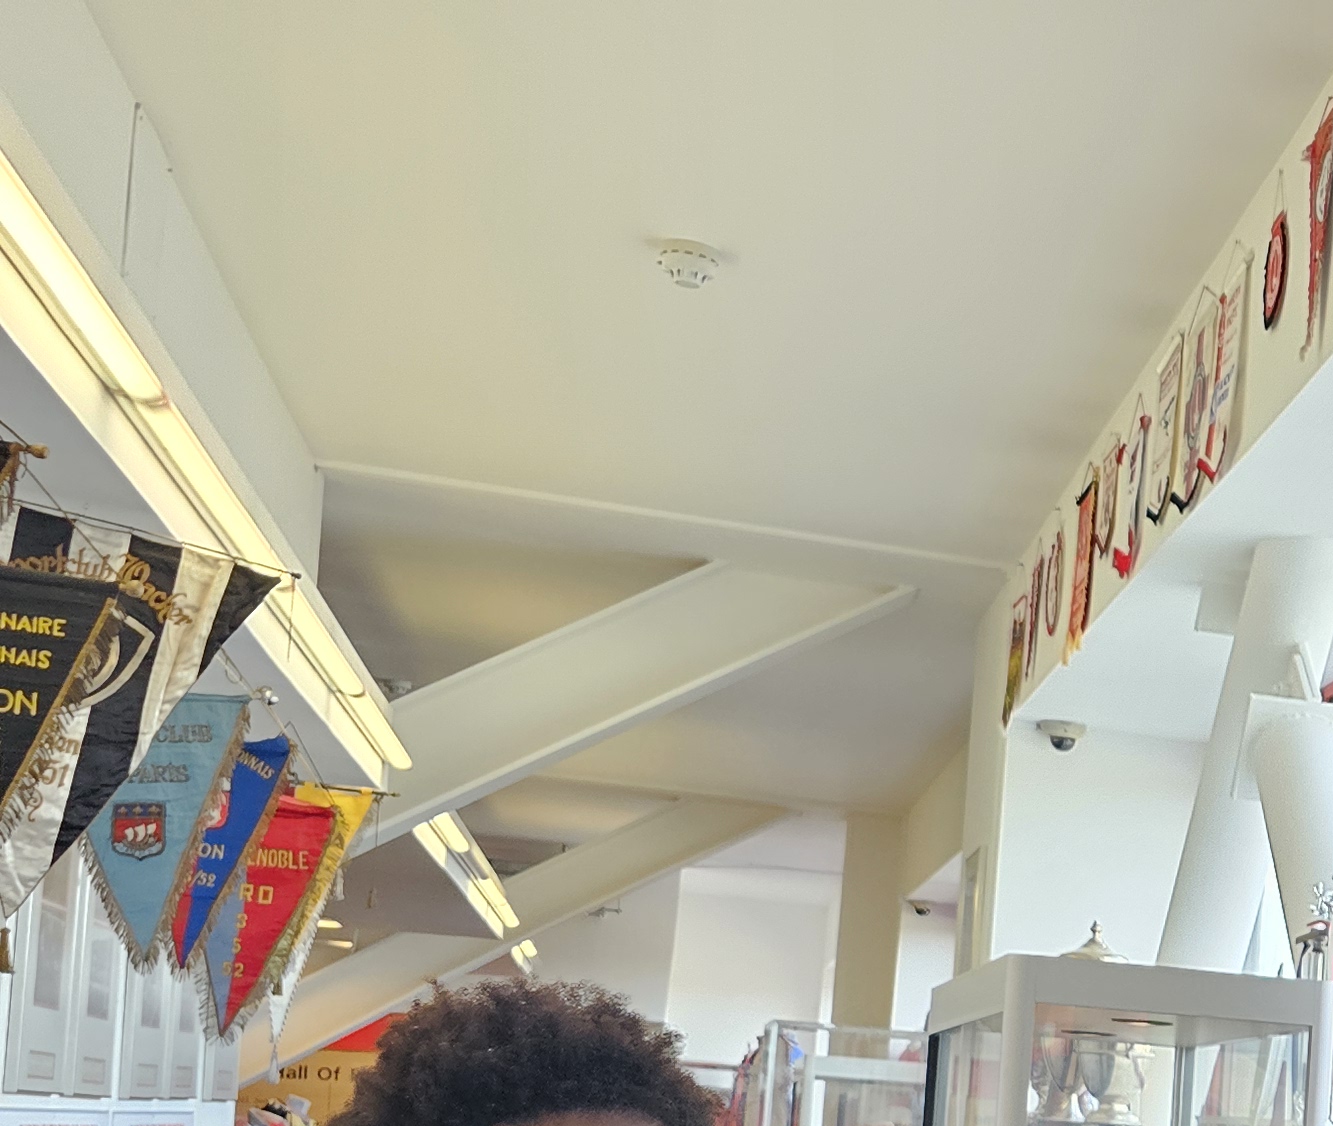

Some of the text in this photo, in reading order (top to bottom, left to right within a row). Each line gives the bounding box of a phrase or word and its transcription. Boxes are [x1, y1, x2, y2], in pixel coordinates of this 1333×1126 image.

[157, 723, 213, 743] CLUB
[128, 762, 190, 783] PARIS
[317, 1066, 341, 1081] Of
